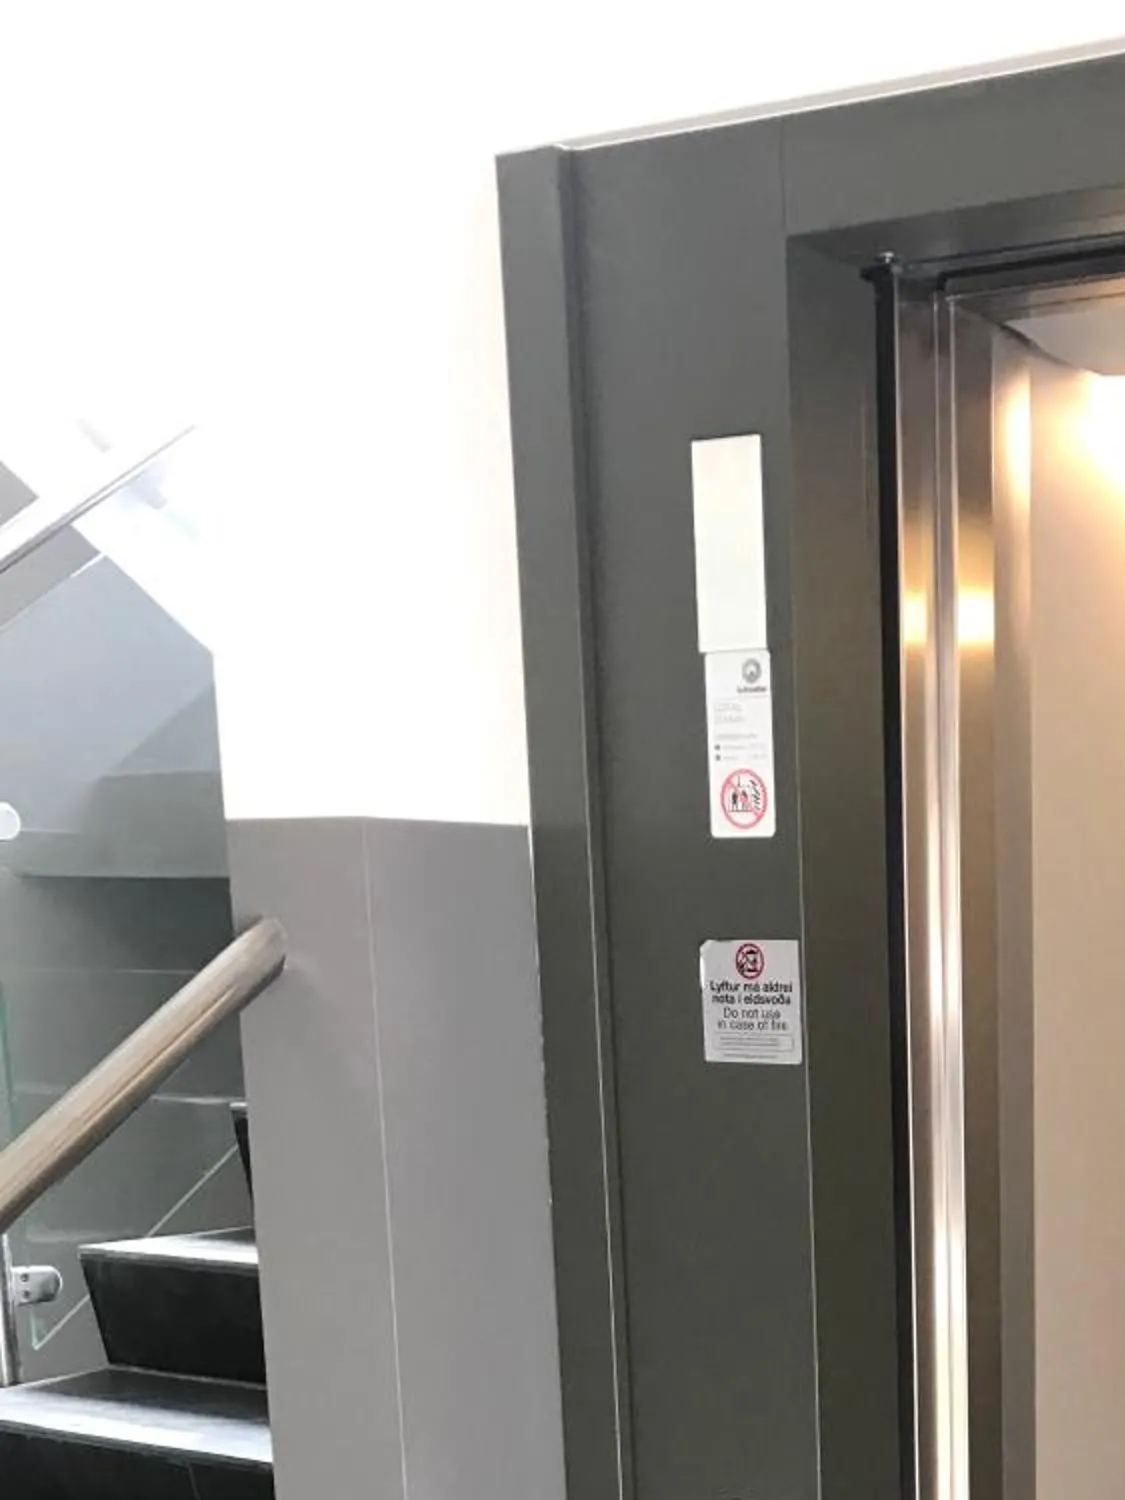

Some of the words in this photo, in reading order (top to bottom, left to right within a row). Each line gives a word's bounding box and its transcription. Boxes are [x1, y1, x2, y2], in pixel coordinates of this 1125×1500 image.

[710, 980, 740, 993] Lyftur
[763, 981, 793, 993] aldrei
[711, 994, 736, 1005] nota
[723, 1006, 739, 1019] Do
[741, 1008, 759, 1019] not
[761, 1009, 782, 1020] use
[717, 1020, 727, 1029] in
[729, 1020, 755, 1031] case
[757, 1020, 769, 1031] of
